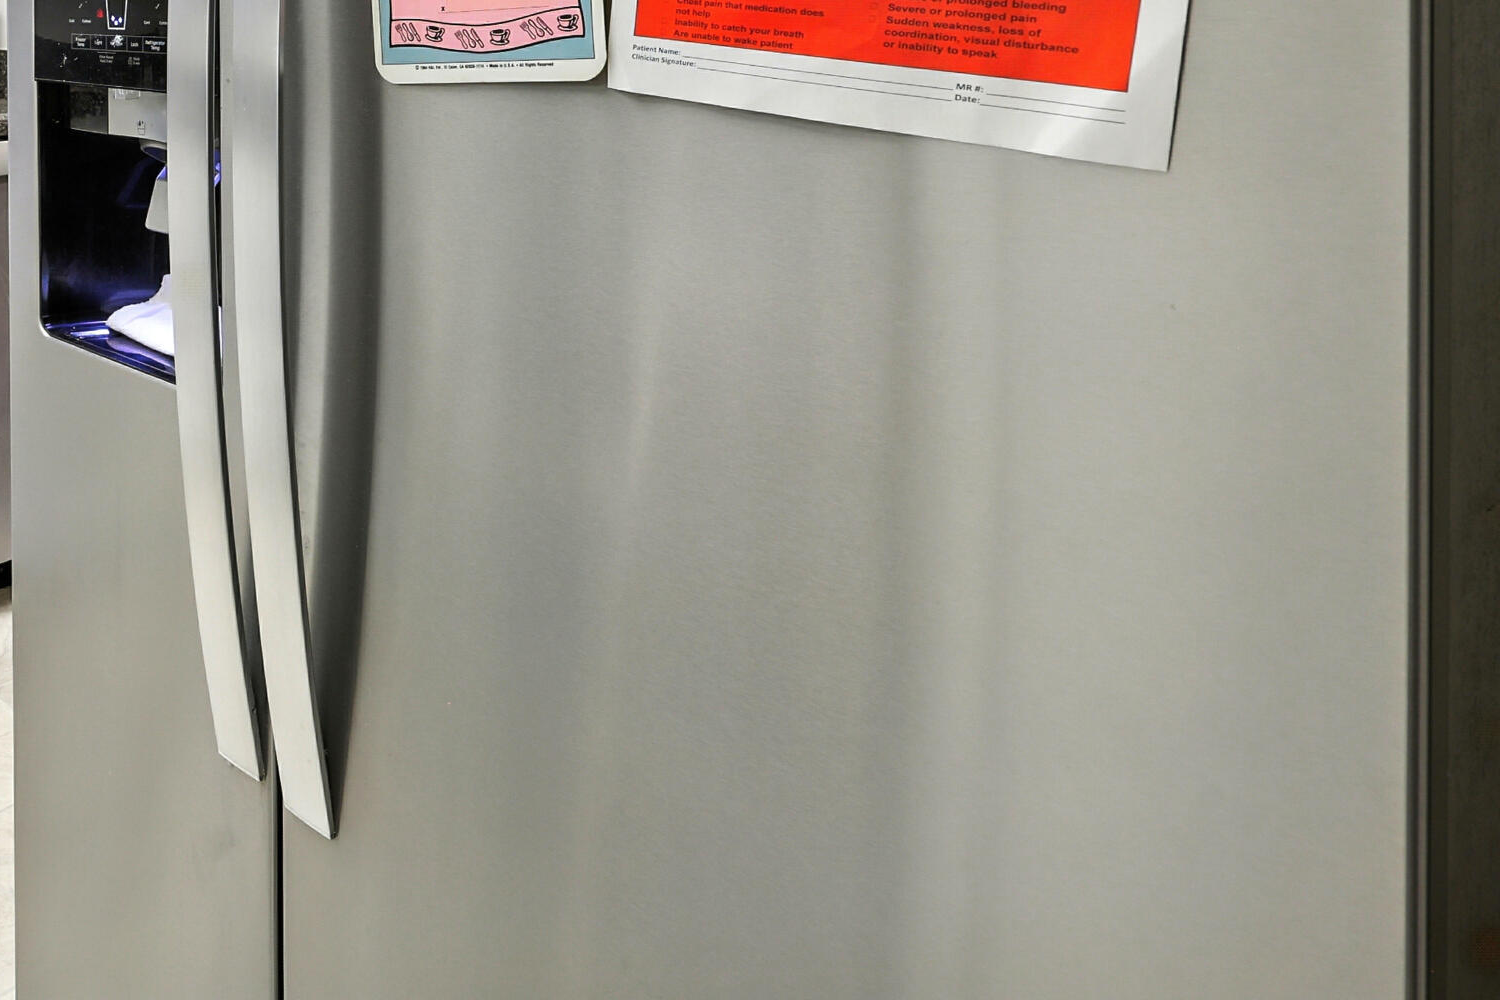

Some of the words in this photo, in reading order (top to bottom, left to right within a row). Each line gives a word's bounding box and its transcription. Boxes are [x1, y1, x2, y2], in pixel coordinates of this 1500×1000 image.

[1011, 0, 1067, 15] bleeding
[632, 43, 657, 53] Patient
[658, 47, 681, 56] Name:
[954, 93, 981, 104] Date:
